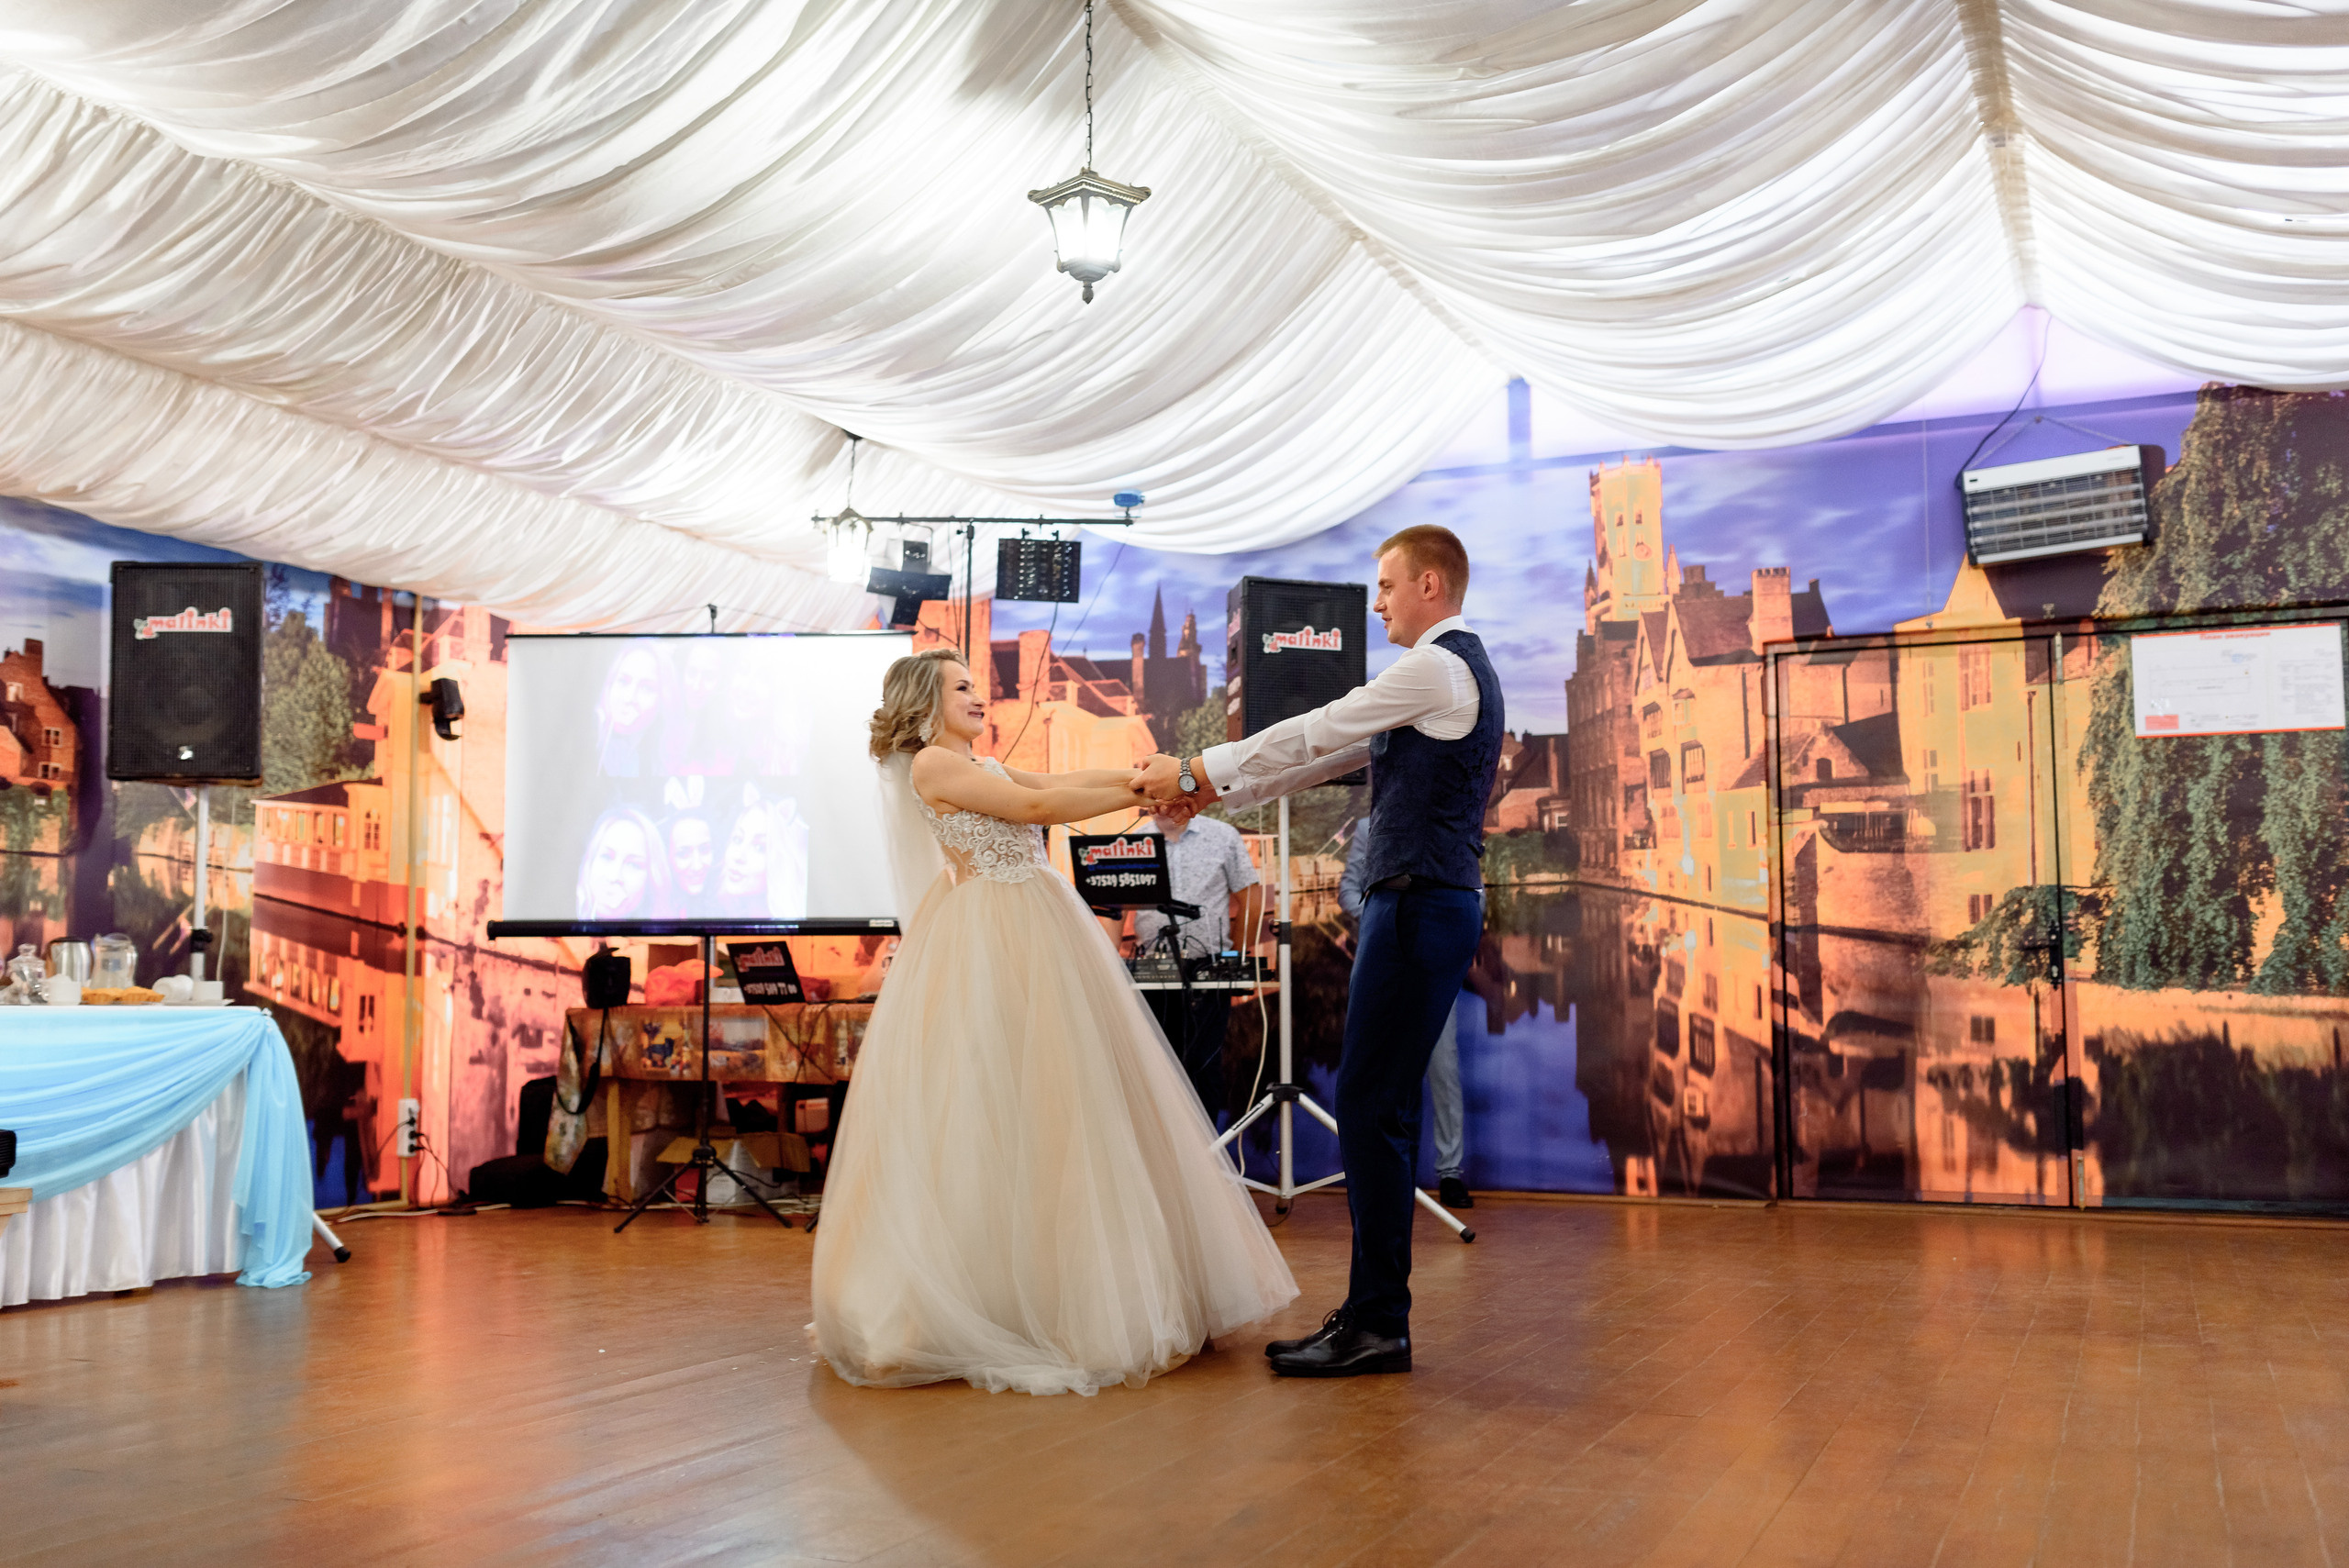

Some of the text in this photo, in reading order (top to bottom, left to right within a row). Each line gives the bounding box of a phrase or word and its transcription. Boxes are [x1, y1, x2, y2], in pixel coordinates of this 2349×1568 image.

[146, 608, 230, 630] malinki
[1274, 628, 1341, 650] malinki
[1088, 837, 1154, 858] malinki
[1085, 873, 1118, 887] +37529
